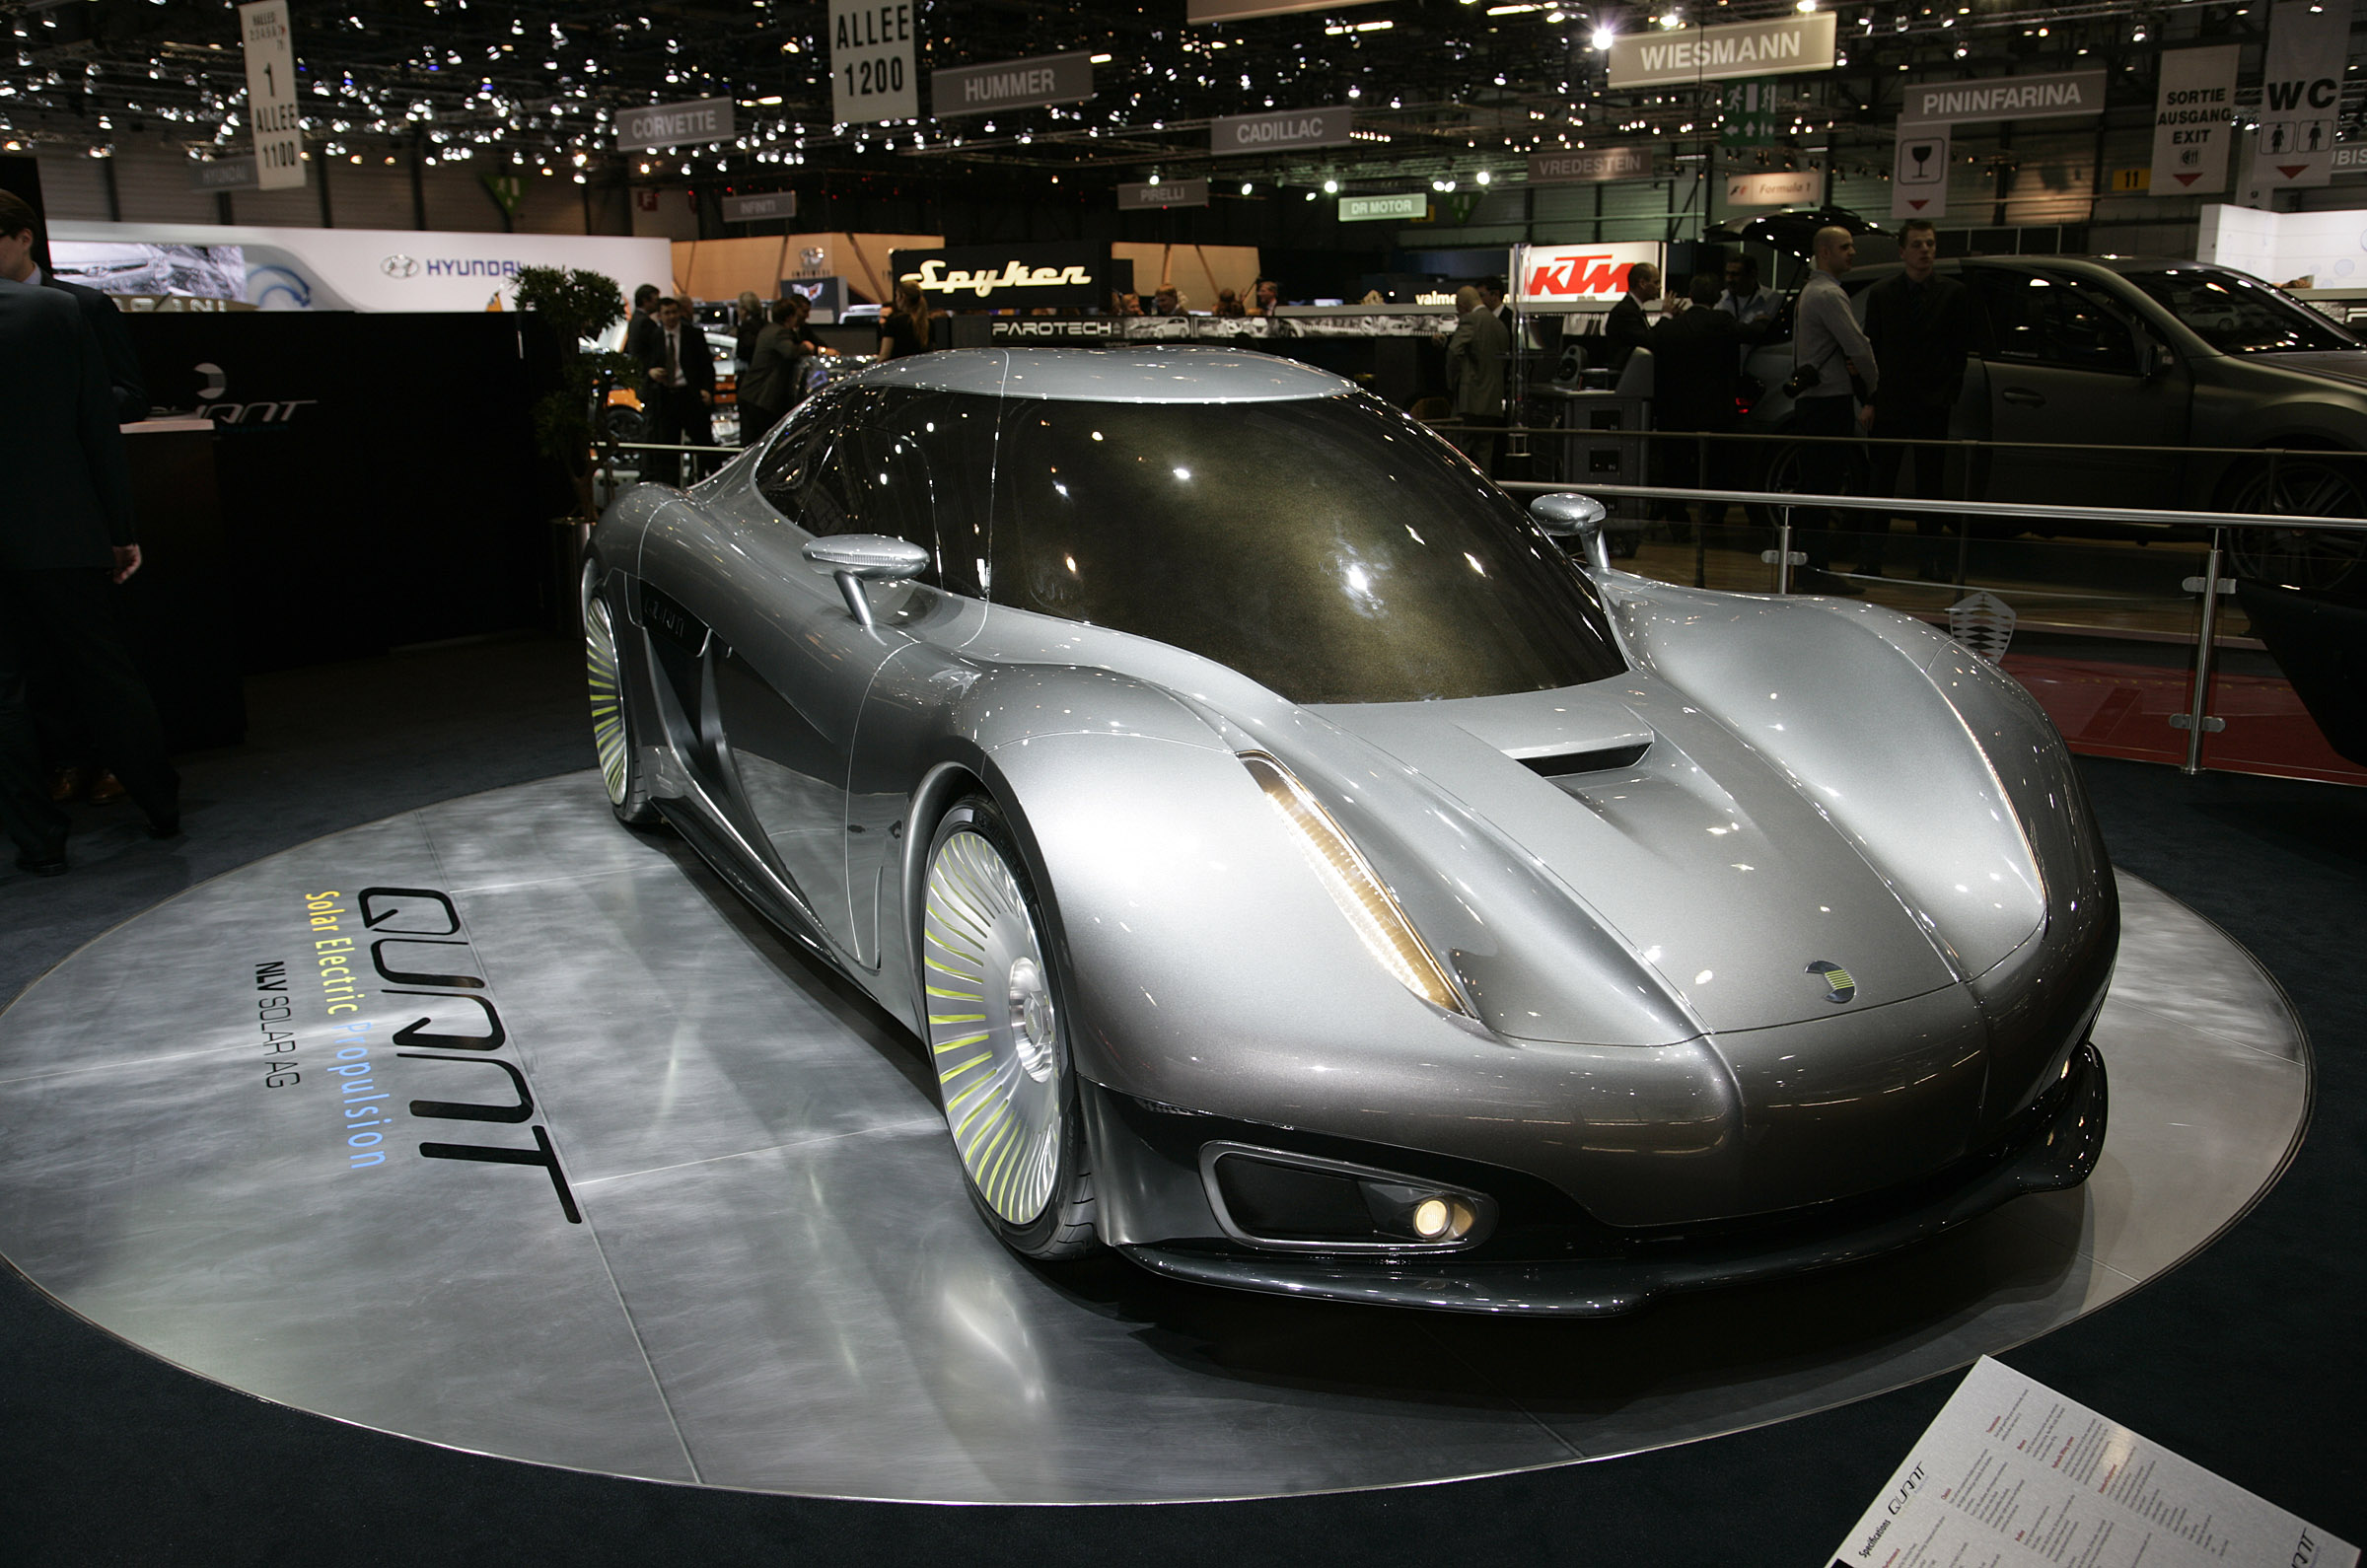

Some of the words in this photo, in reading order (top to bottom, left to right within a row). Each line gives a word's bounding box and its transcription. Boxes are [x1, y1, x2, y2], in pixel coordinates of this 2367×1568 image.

[836, 5, 908, 49] ALLEE
[1640, 31, 1801, 71] WIESMANN
[263, 62, 275, 97] 1
[844, 56, 902, 96] 1200
[965, 68, 1055, 102] HUMMER
[1923, 82, 2082, 115] PININFARINA
[2167, 88, 2226, 106] SORTIE
[2267, 78, 2337, 110] WC
[255, 104, 297, 133] ALLEE
[631, 109, 717, 138] CORVETTE
[1237, 117, 1324, 143] CADILLAC
[2158, 107, 2231, 125] AUSGANG
[2173, 128, 2211, 145] EXIT
[262, 141, 296, 168] 1100
[1539, 154, 1642, 177] VREDESTEIN
[1140, 186, 1184, 202] PIRELLI
[1759, 181, 1803, 194] Formula
[2124, 170, 2139, 188] 11
[1351, 201, 1368, 214] DR
[1370, 199, 1412, 214] MOTOR
[899, 258, 1092, 298] Spyker
[1530, 254, 1636, 295] KTM
[992, 321, 1112, 336] PAROTECH
[305, 891, 345, 932] Solar
[254, 961, 289, 991] NLV
[315, 937, 366, 1015] Electric
[258, 995, 297, 1056] SOLAR
[357, 887, 583, 1225] QUANT
[264, 1061, 301, 1089] AG
[326, 1021, 393, 1170] Propulsion
[1859, 1520, 1892, 1558] Specifications
[1888, 1461, 1925, 1516] QUANT
